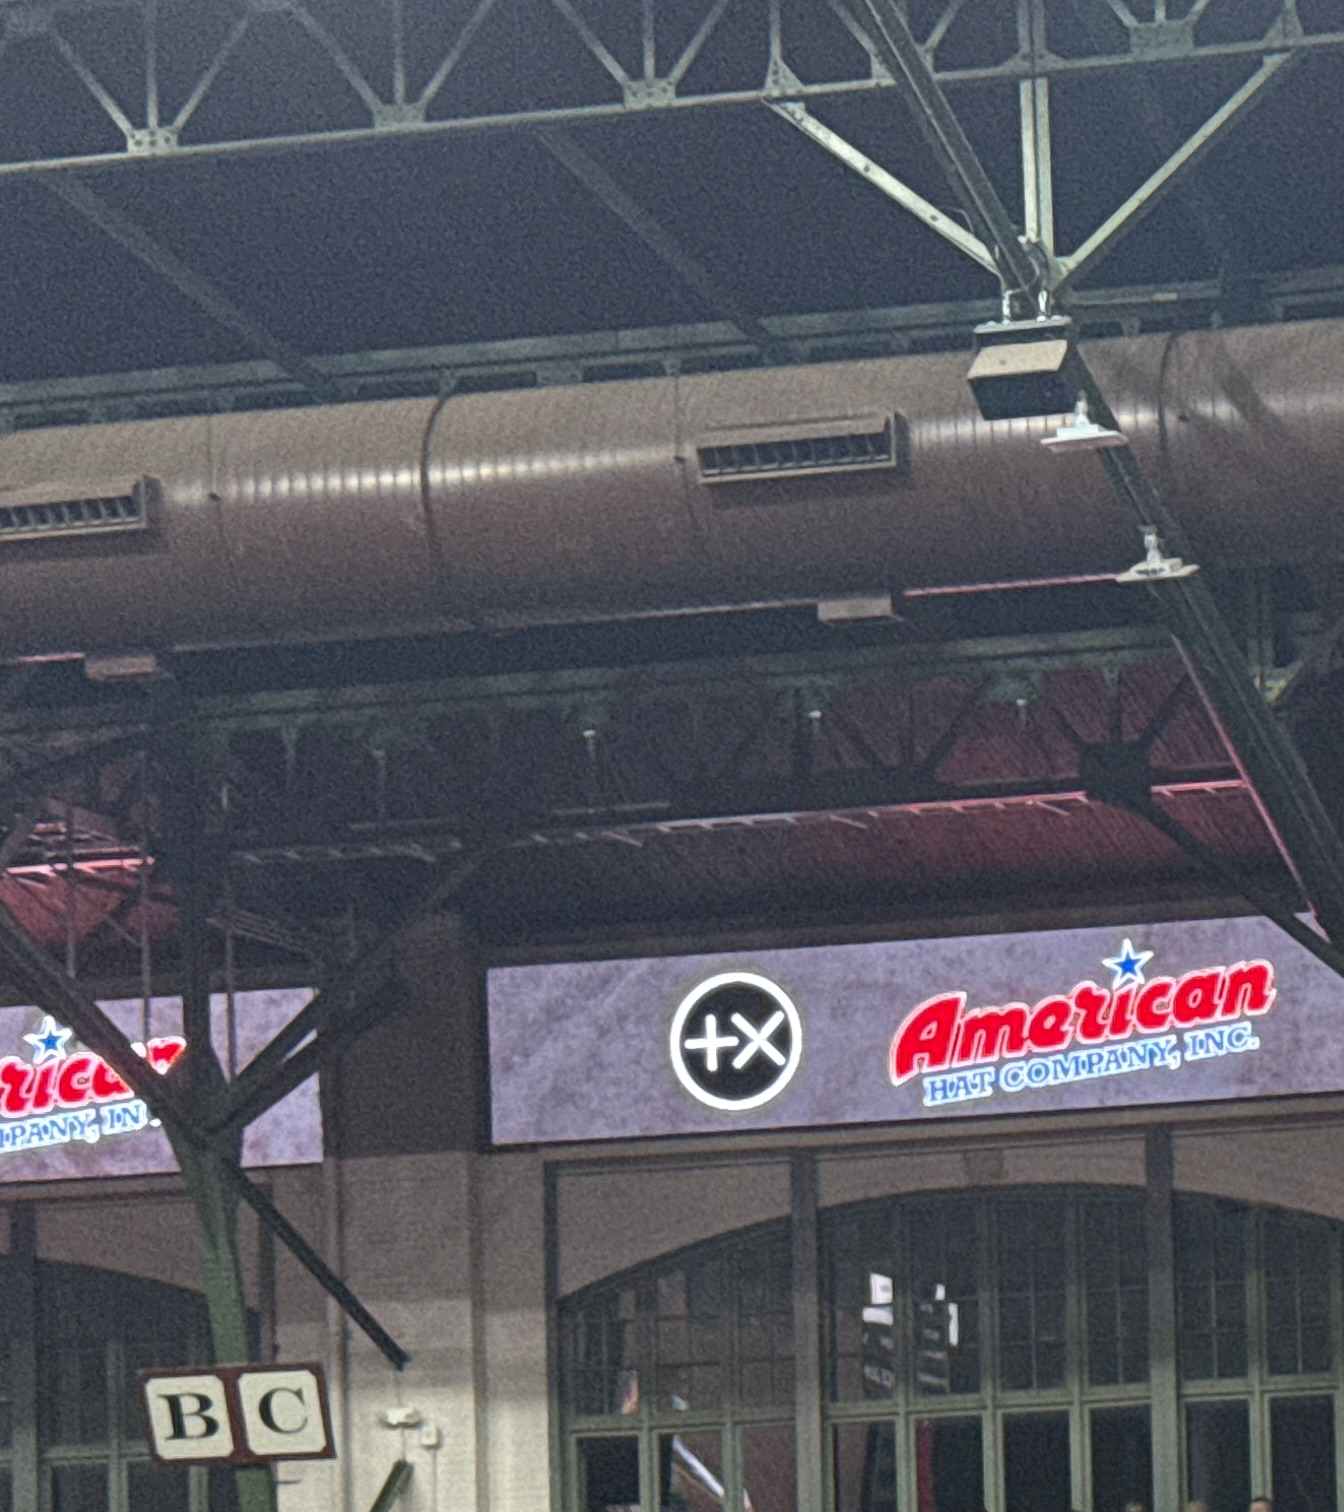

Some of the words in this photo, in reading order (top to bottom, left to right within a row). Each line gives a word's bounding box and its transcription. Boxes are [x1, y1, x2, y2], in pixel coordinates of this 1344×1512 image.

[889, 959, 1277, 1086] American
[923, 1066, 998, 1105] HAT
[1001, 1034, 1183, 1091] COMPANY,
[1184, 1022, 1260, 1060] INC.
[157, 1392, 219, 1441] B
[259, 1387, 308, 1433] C
